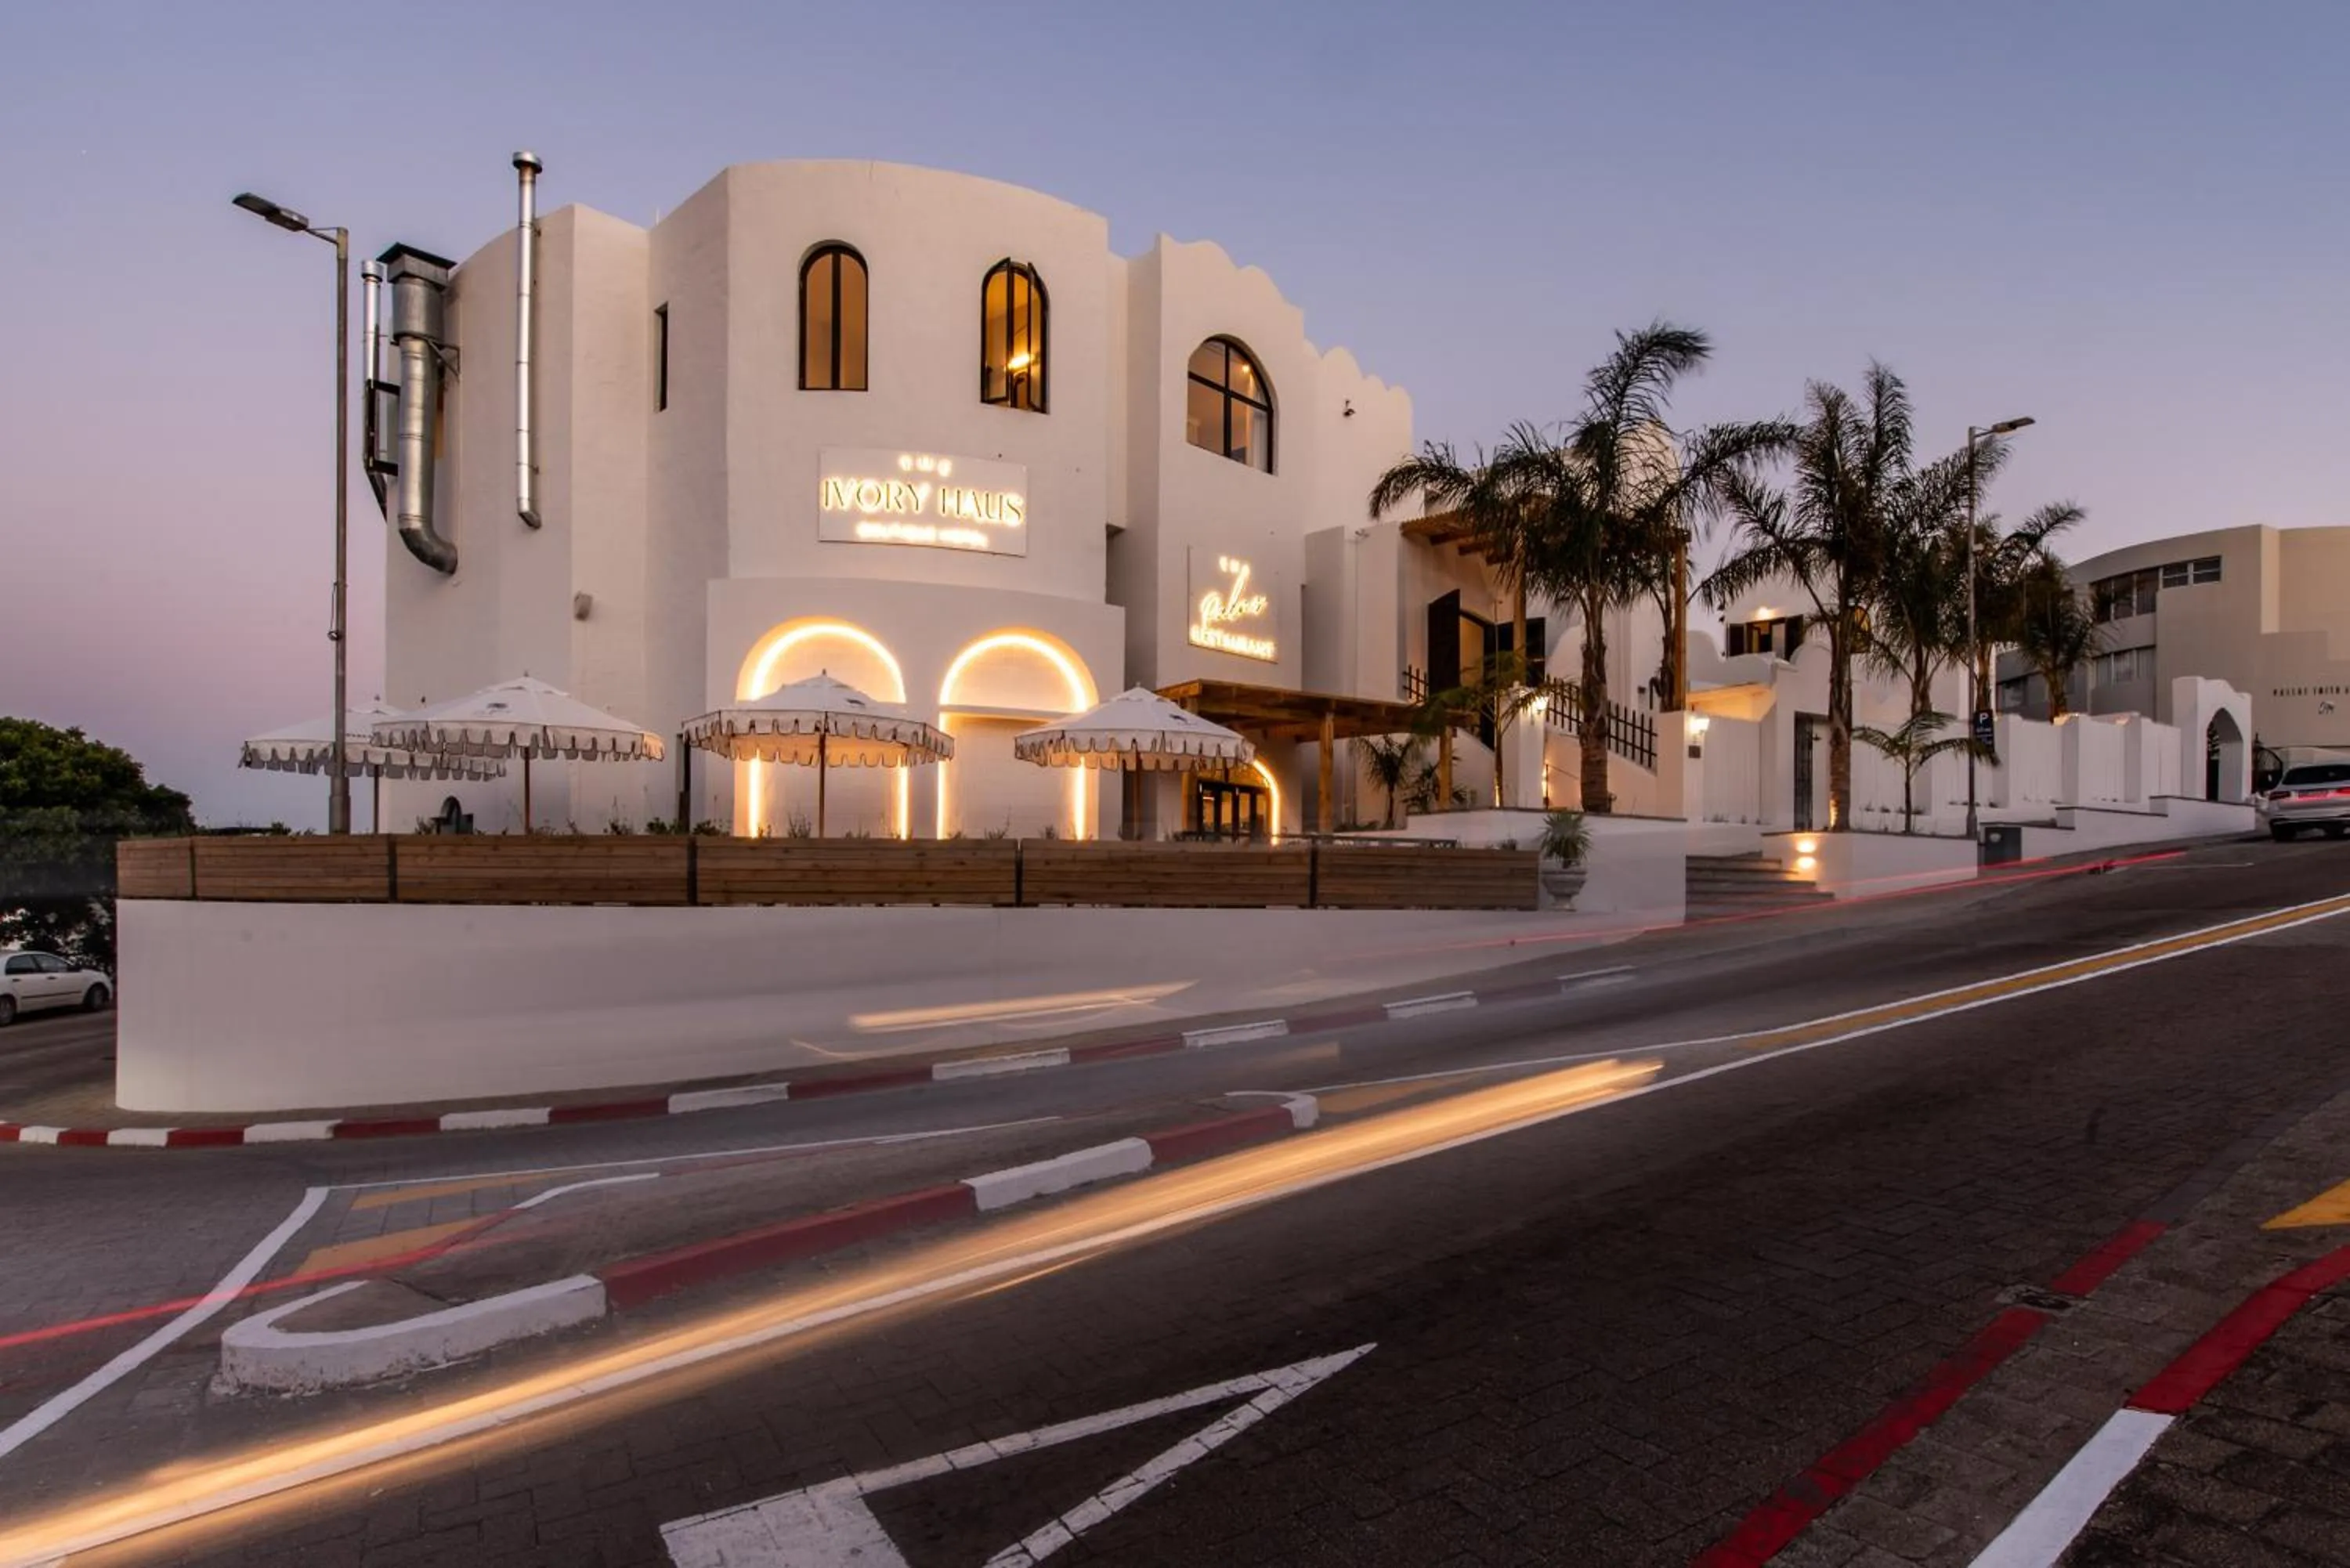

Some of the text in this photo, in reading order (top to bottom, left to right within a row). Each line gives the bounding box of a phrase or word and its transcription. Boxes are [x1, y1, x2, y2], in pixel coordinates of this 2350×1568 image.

[822, 477, 1025, 526] IVORY HAUS
[1979, 713, 1989, 724] P
